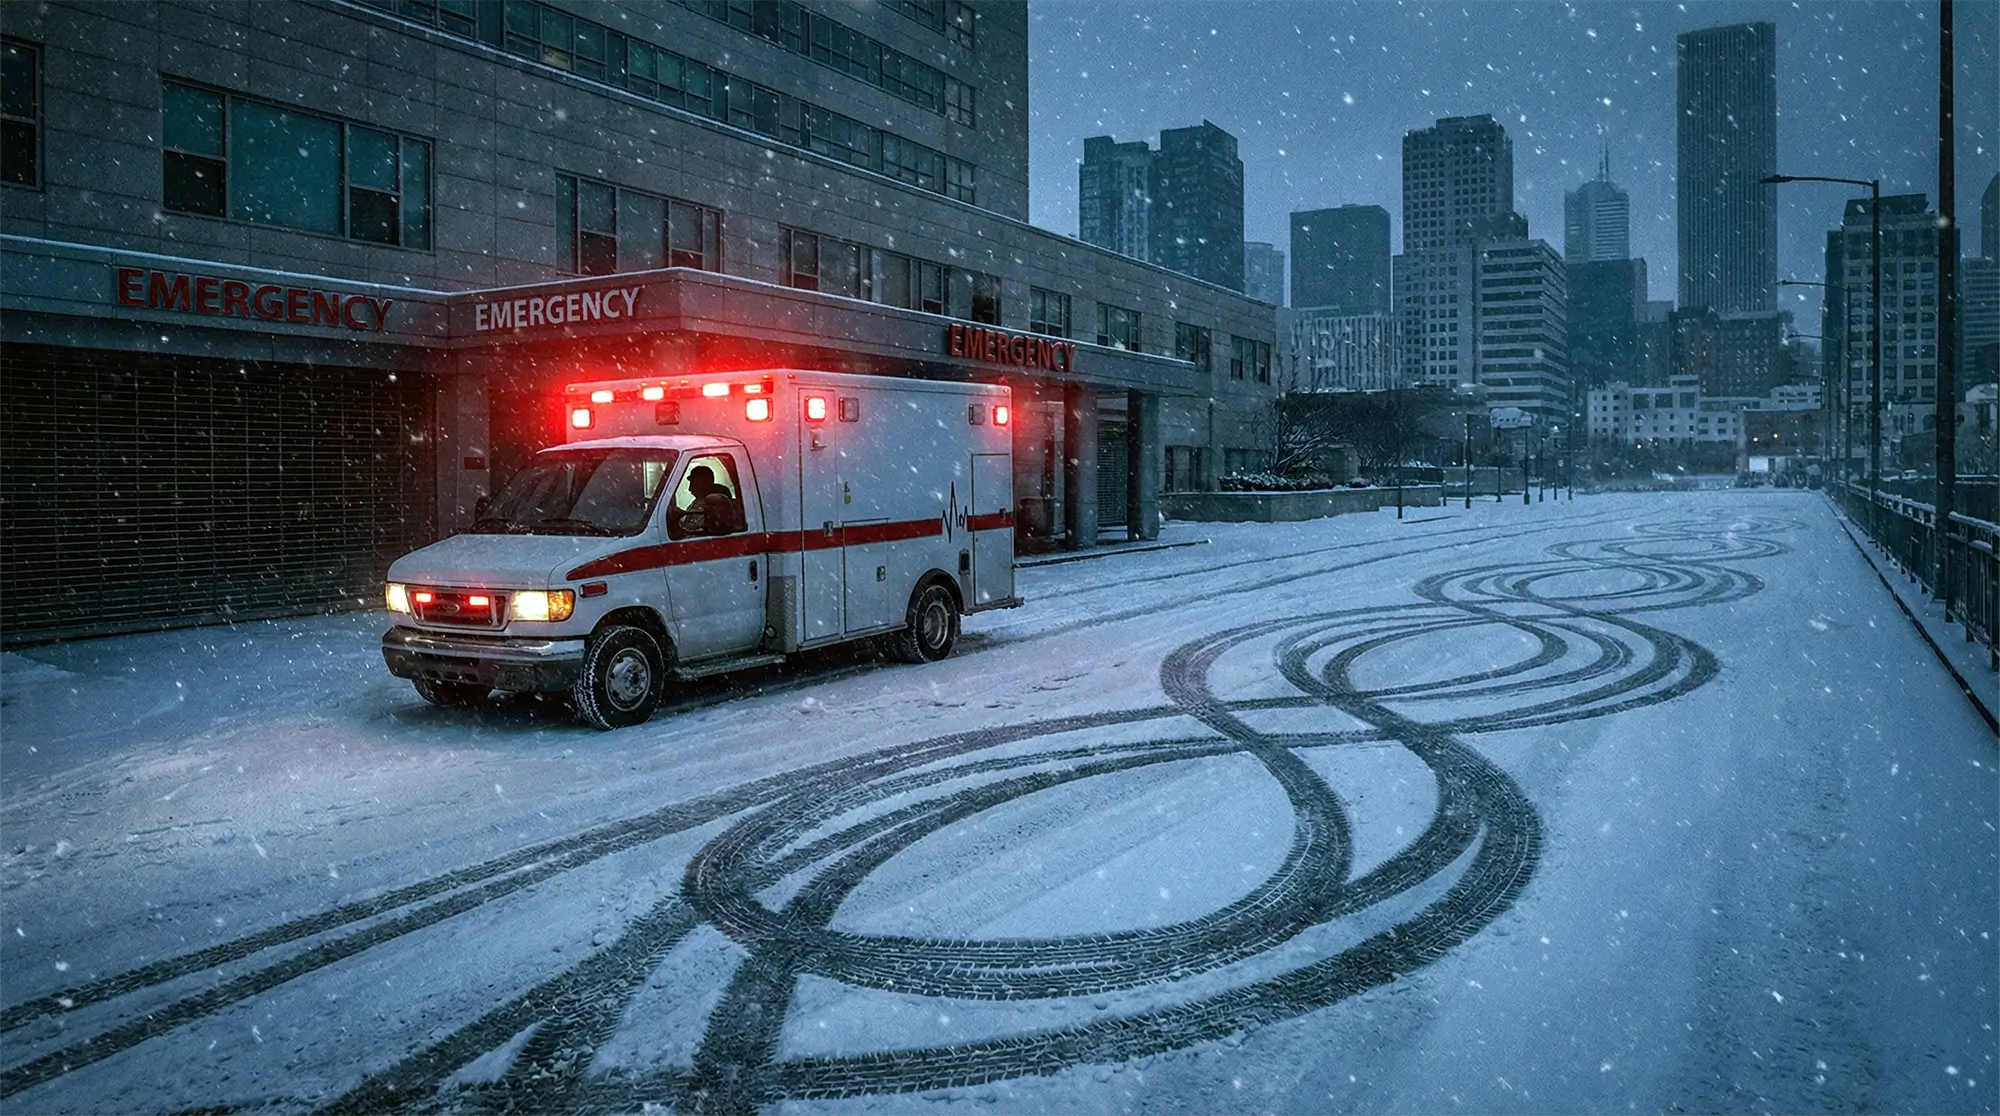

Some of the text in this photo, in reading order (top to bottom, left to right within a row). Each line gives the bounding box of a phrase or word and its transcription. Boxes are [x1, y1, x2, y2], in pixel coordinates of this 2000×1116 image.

[118, 267, 393, 332] EMERGENCY
[475, 287, 640, 331] EMERGENCY
[948, 323, 1077, 372] EMERGENCY
